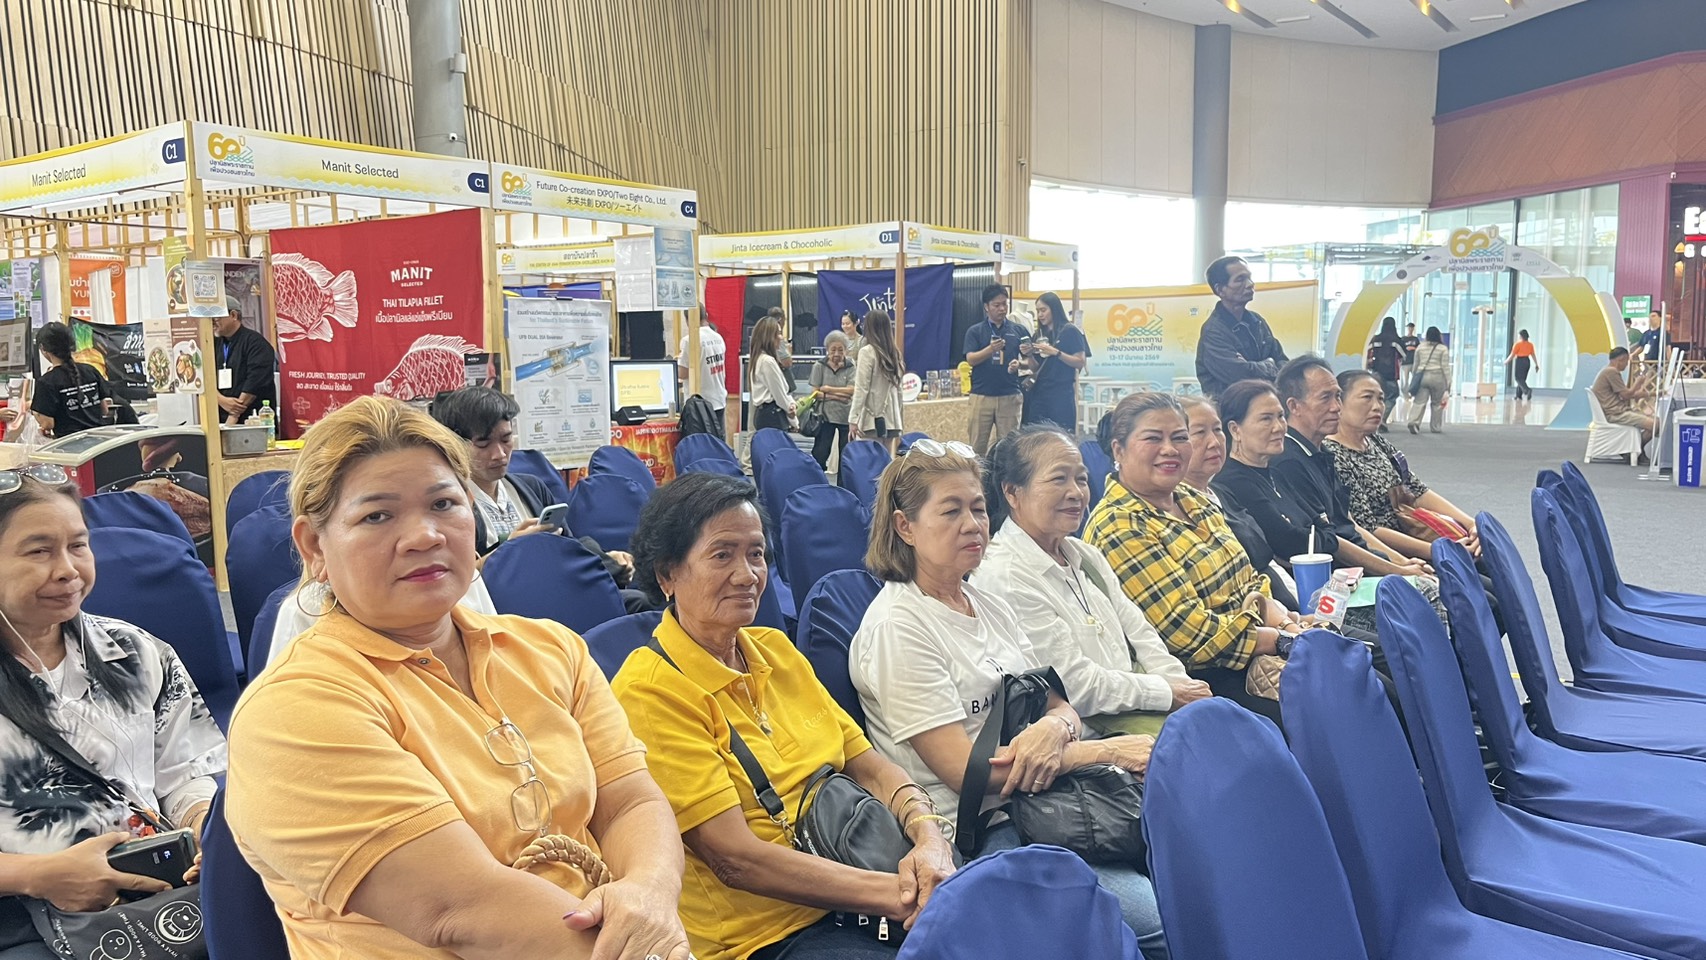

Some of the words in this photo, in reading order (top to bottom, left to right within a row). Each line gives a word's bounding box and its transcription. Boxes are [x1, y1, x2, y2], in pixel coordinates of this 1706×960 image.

[166, 144, 178, 160] C1
[32, 172, 52, 187] Manit
[53, 164, 86, 182] Selected
[322, 160, 351, 172] Manit
[355, 164, 399, 178] Selected
[474, 178, 485, 188] C1
[536, 181, 558, 192] Future
[560, 184, 596, 196] Co-creation
[597, 188, 628, 200] EXPO/Two
[629, 193, 644, 203] Eight
[656, 196, 668, 205] Ltd.
[684, 204, 694, 214] C4
[882, 232, 892, 242] D1
[732, 244, 748, 254] Jinta
[750, 241, 782, 252] Icecream
[784, 240, 789, 250] &
[790, 238, 832, 250] Chocoholic
[390, 266, 433, 283] MANIT
[382, 298, 397, 308] THAI
[398, 298, 423, 307] TILAPIA
[424, 295, 444, 306] FILLET
[348, 372, 366, 381] QUALITY
